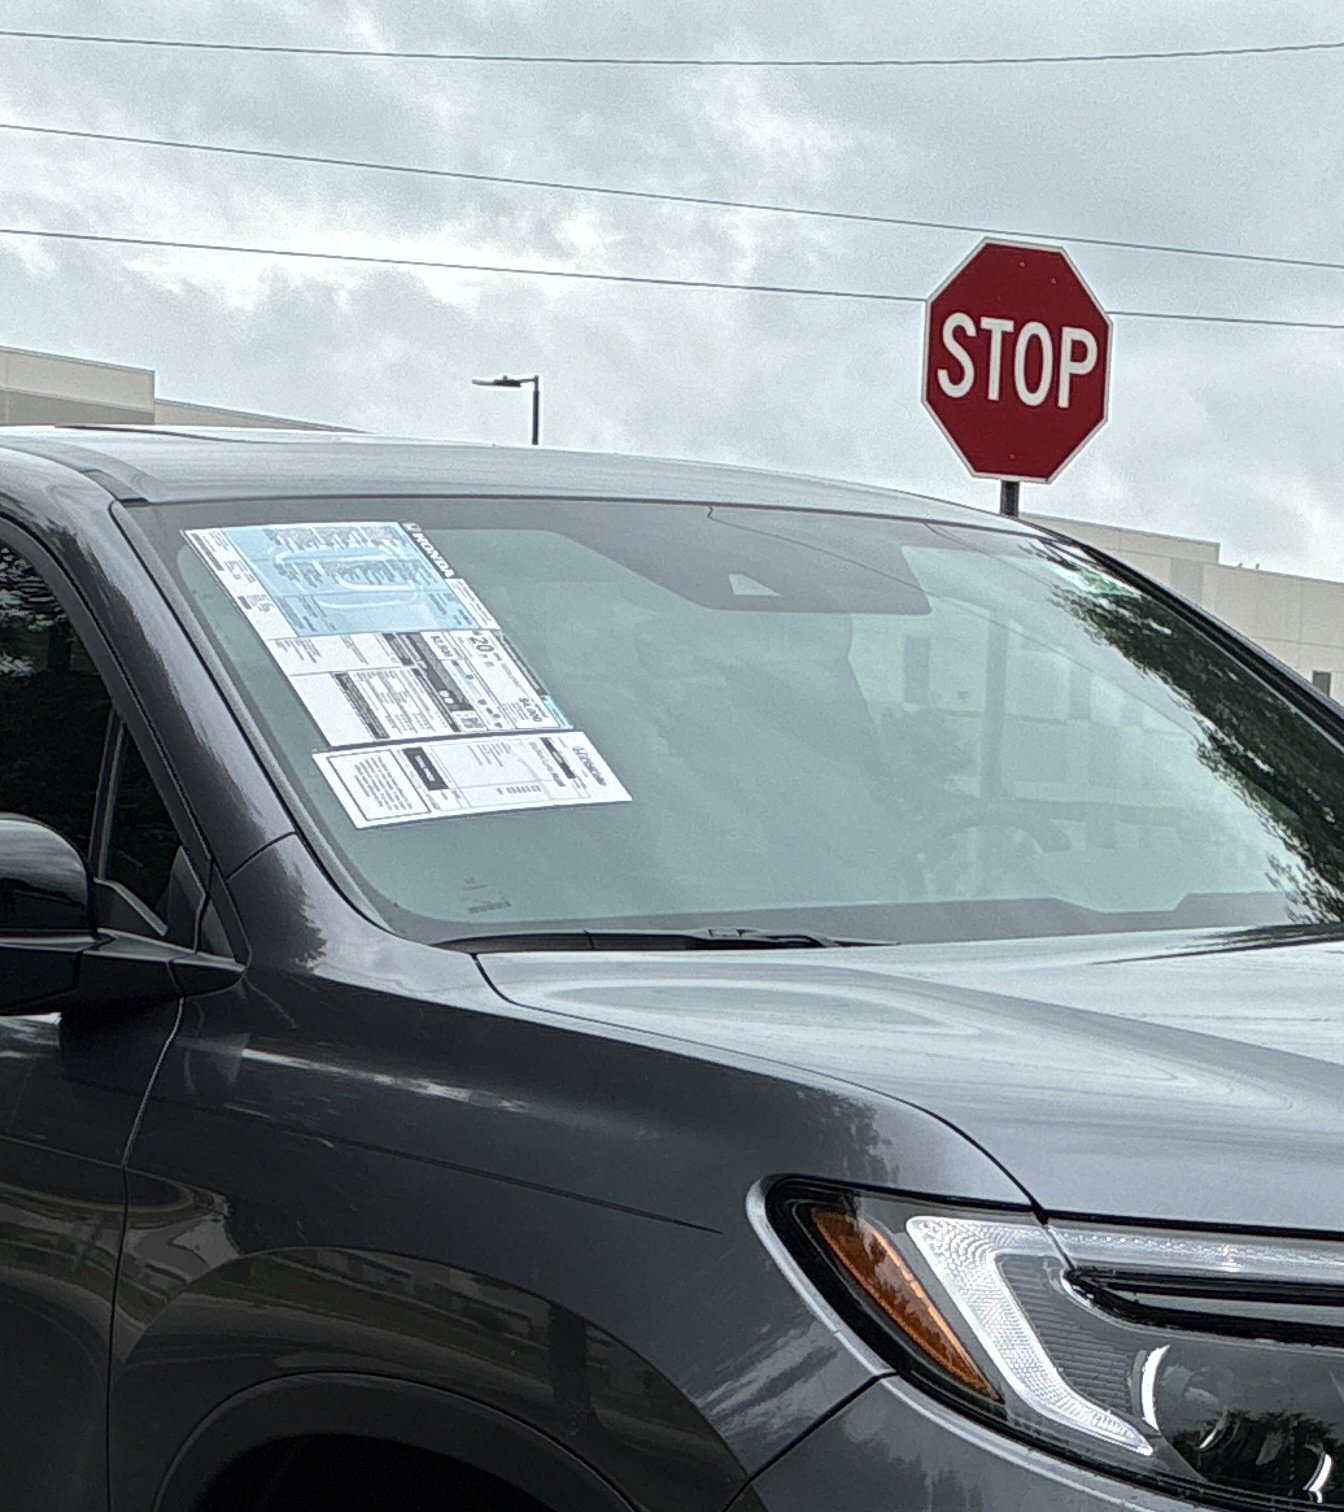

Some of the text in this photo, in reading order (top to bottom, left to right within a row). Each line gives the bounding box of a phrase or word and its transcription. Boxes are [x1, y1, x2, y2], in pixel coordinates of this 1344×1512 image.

[937, 312, 1097, 408] STOP
[411, 531, 455, 578] HONDA
[469, 637, 495, 652] 20
